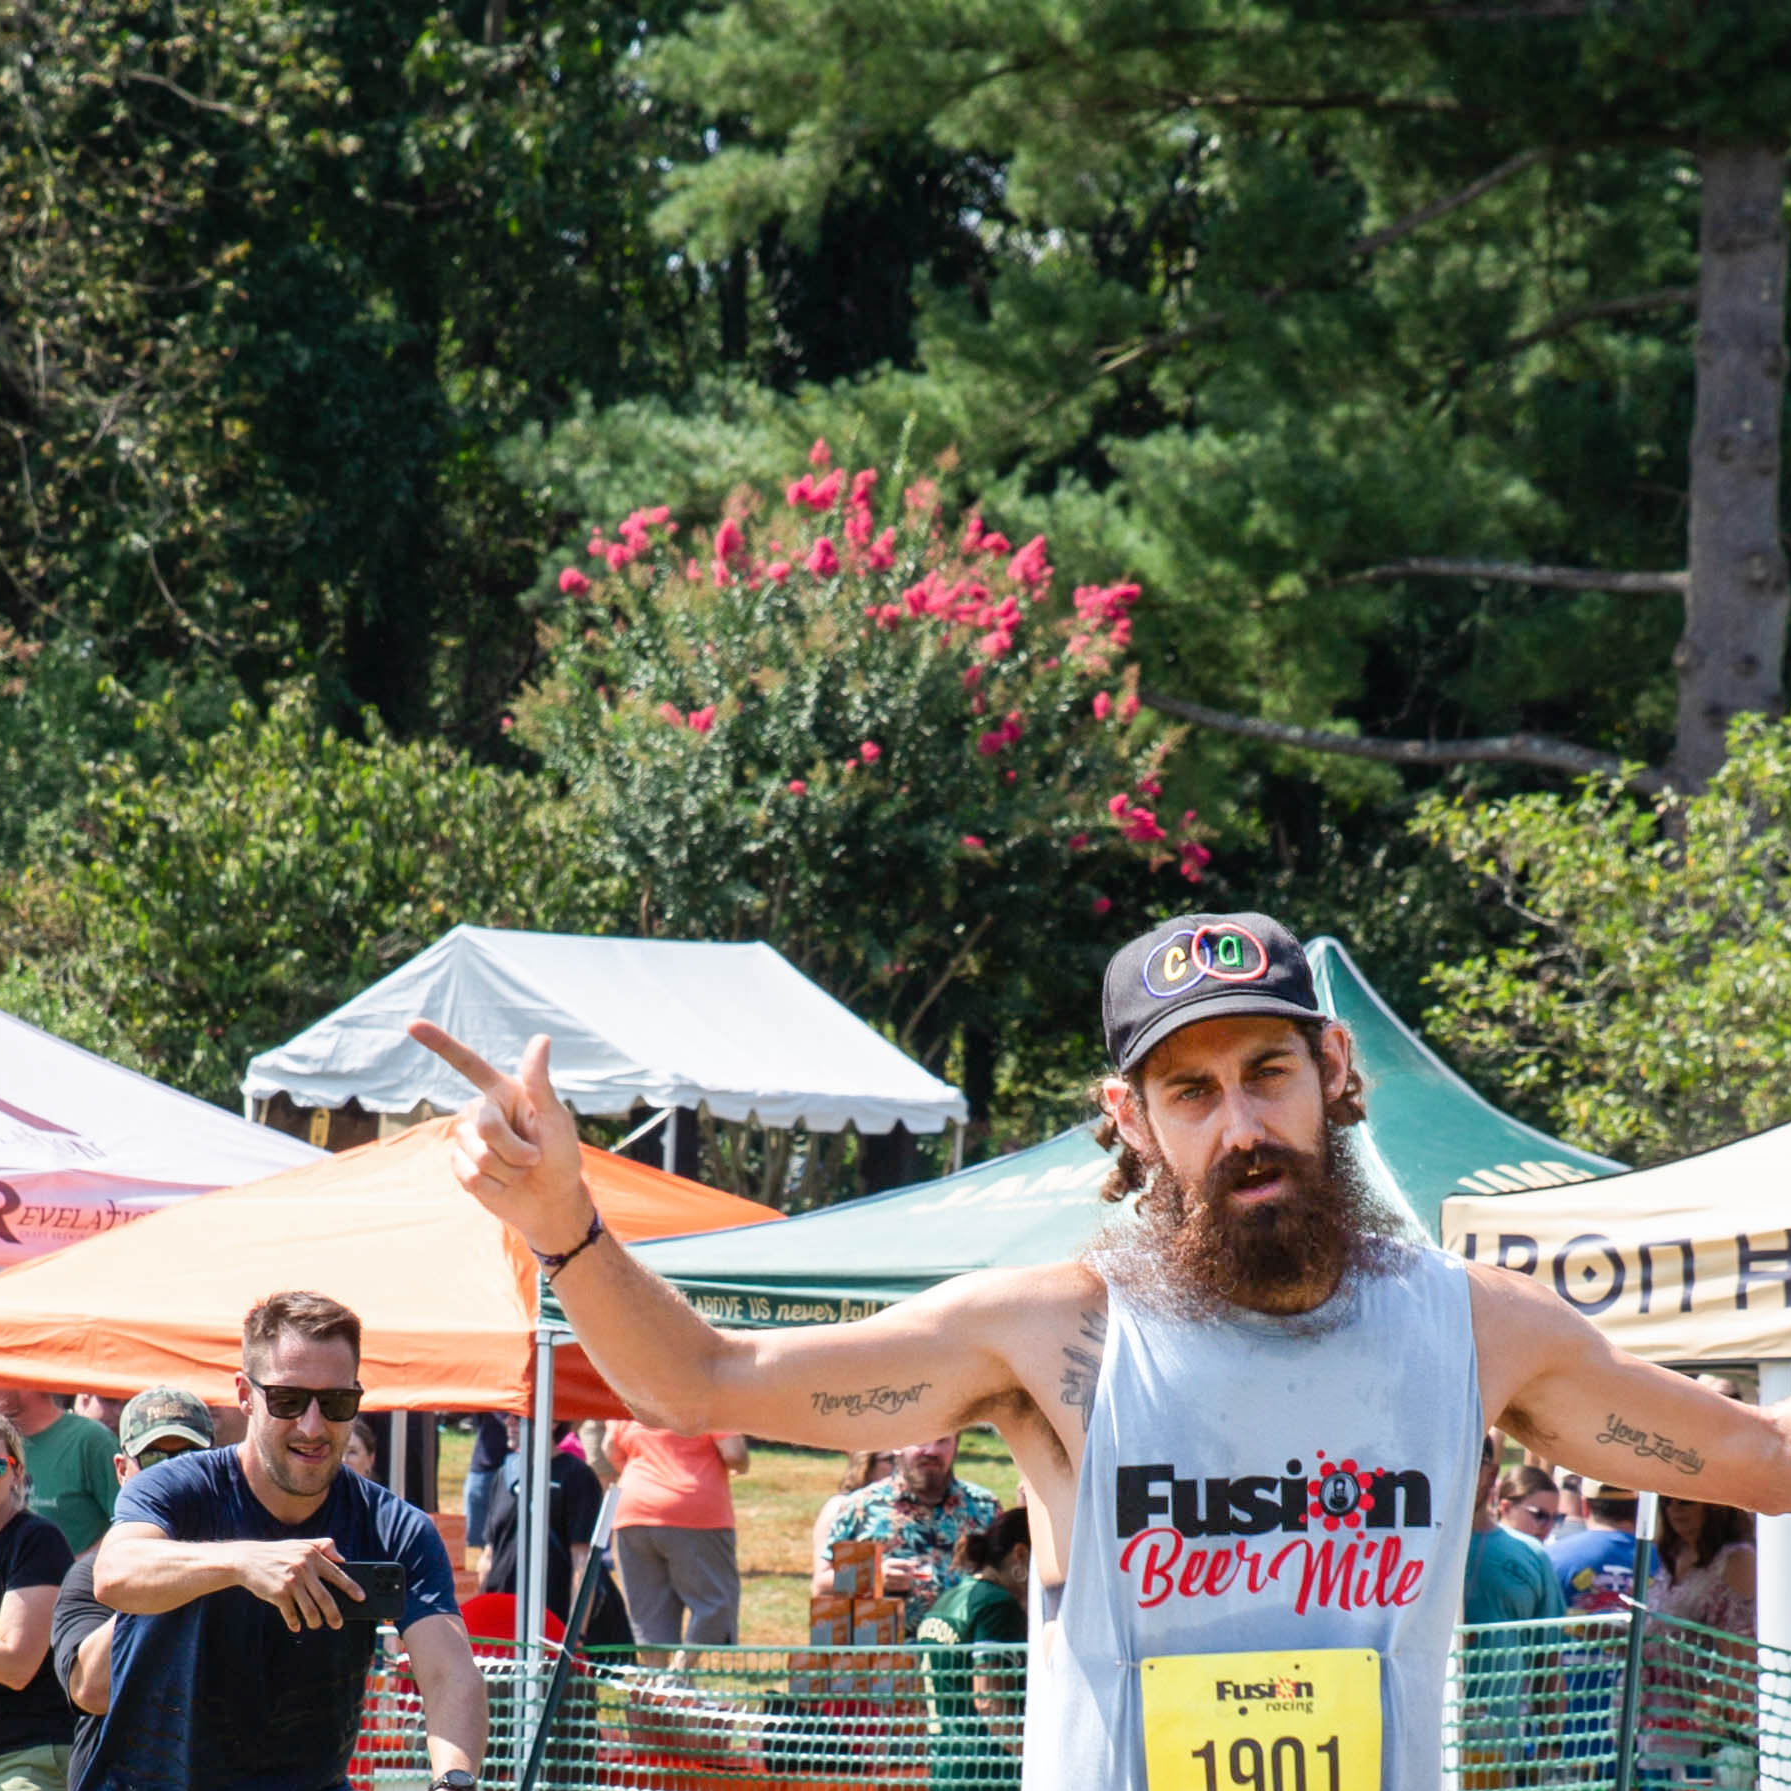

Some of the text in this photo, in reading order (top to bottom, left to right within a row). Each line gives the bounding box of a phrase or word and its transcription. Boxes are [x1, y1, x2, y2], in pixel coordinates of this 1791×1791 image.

[749, 1299, 772, 1322] US
[775, 1300, 838, 1323] never
[1116, 1455, 1432, 1540] Fusion
[1119, 1528, 1426, 1617] Beer Mile
[1216, 1677, 1314, 1701] Fusion
[1265, 1699, 1314, 1714] racing
